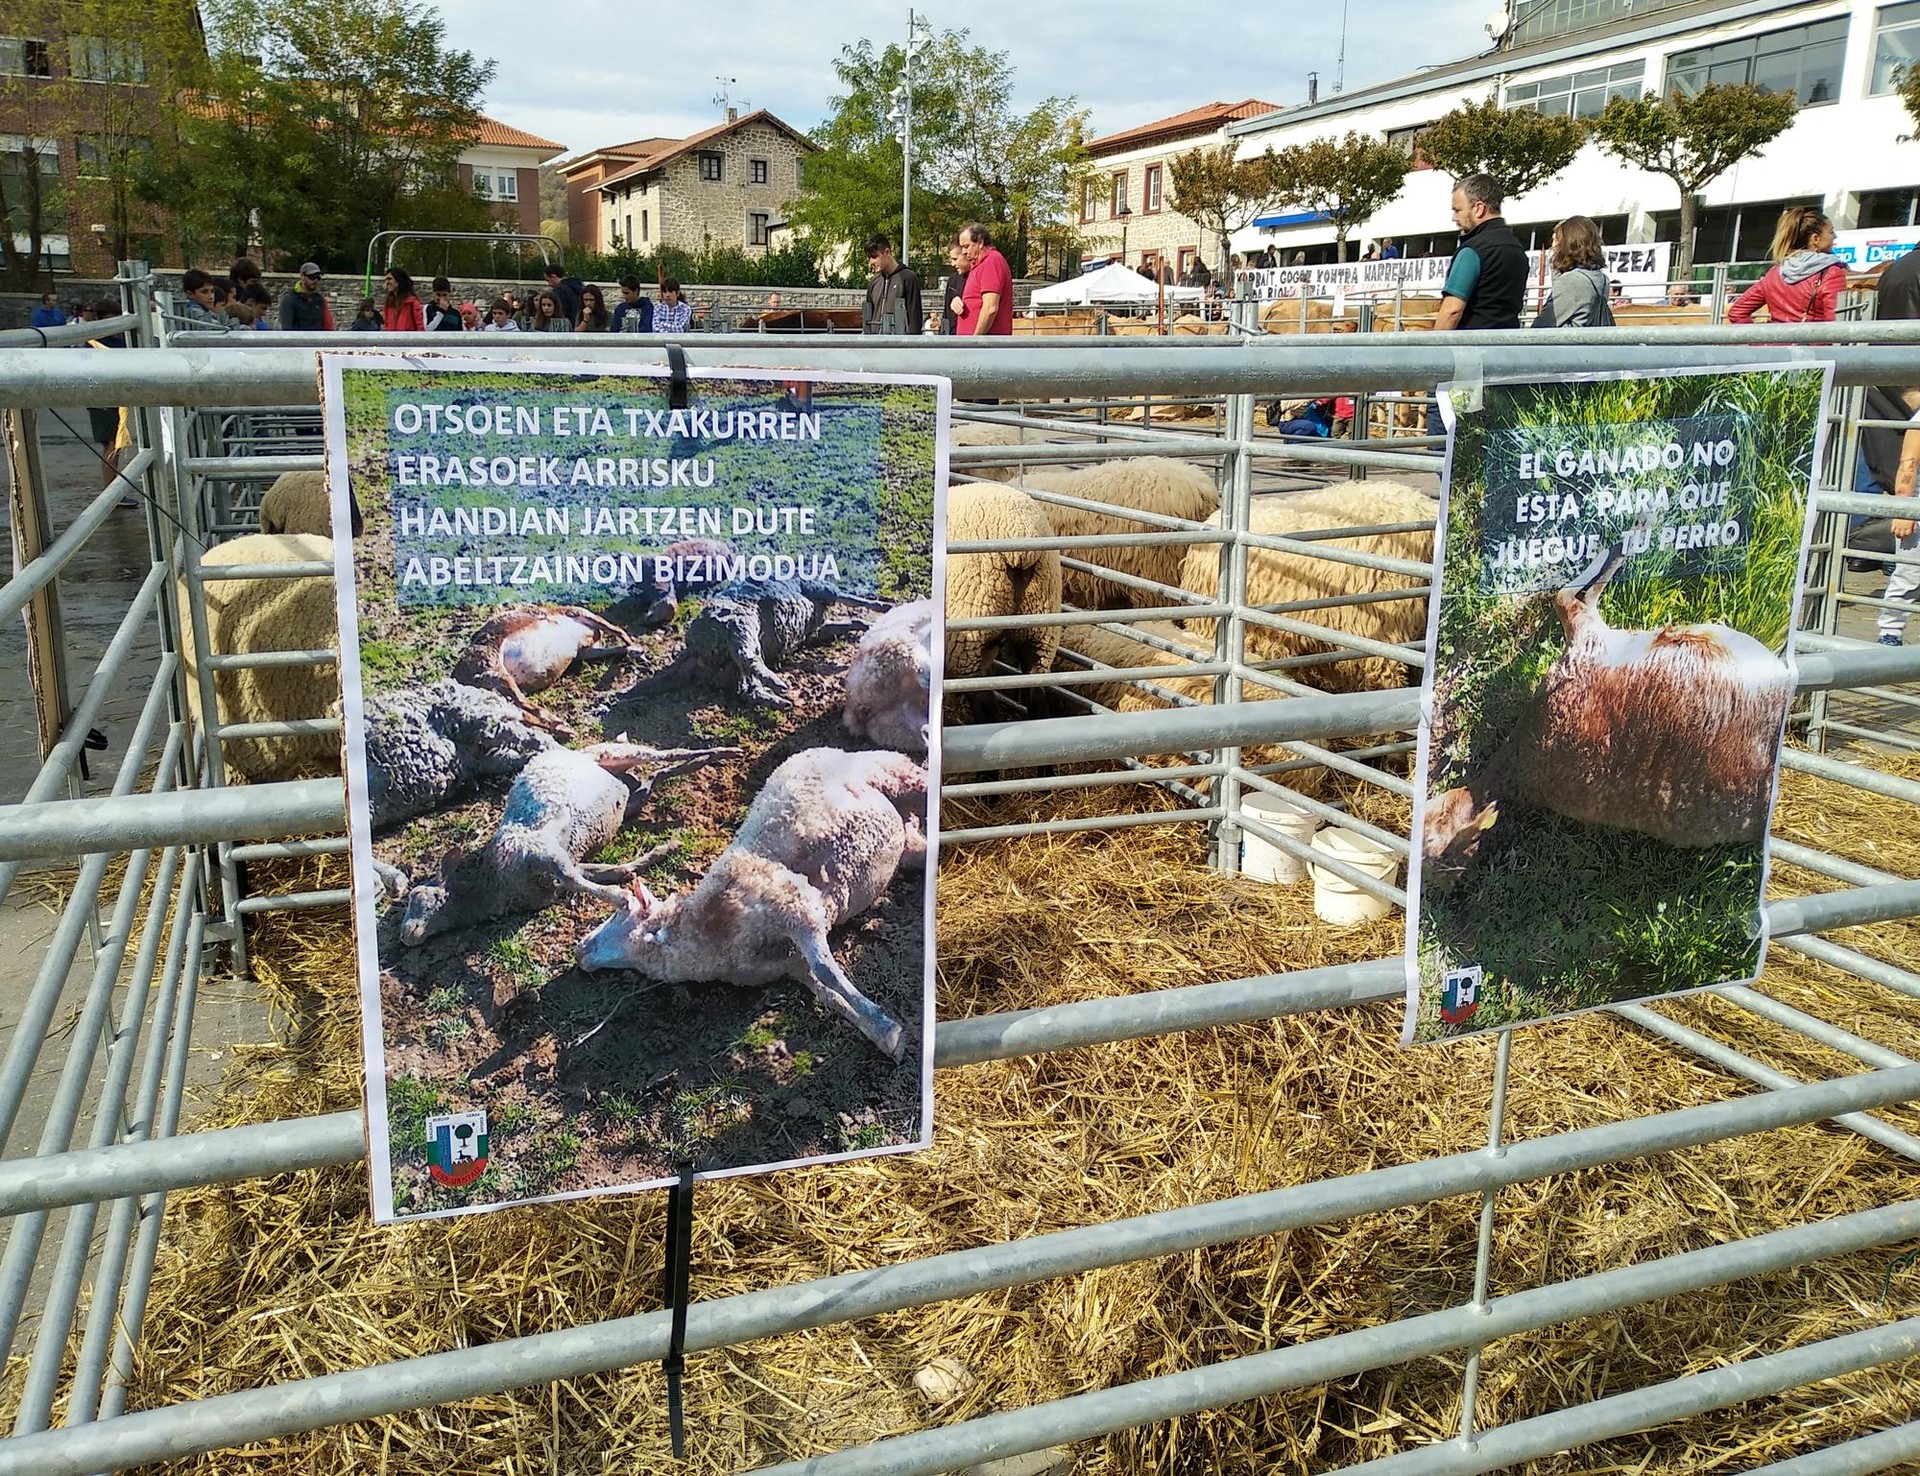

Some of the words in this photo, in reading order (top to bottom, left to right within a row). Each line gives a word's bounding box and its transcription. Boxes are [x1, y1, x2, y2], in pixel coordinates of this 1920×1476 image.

[1608, 249, 1656, 273] TZEA
[395, 405, 540, 435] OTSOEN
[553, 407, 614, 437] ETA
[623, 409, 821, 440] TXAKURREN
[399, 456, 560, 486] ERASOEK
[570, 459, 714, 487] ARRISKU
[1519, 453, 1546, 479] EL
[1556, 446, 1684, 476] GANADO
[1692, 439, 1735, 467] NO
[1516, 493, 1580, 523] ESTA
[1598, 486, 1670, 517] PARA
[1679, 482, 1731, 510] QUE
[401, 507, 570, 536] HANDIAN
[579, 508, 721, 536] JARTZEN
[733, 508, 816, 535] DUTE
[1494, 535, 1601, 568] JUEGUE
[1621, 529, 1652, 556] TU
[1659, 521, 1740, 551] PERRO
[403, 556, 644, 586] ABELTZAINON
[655, 554, 842, 583] BIZIMODUA
